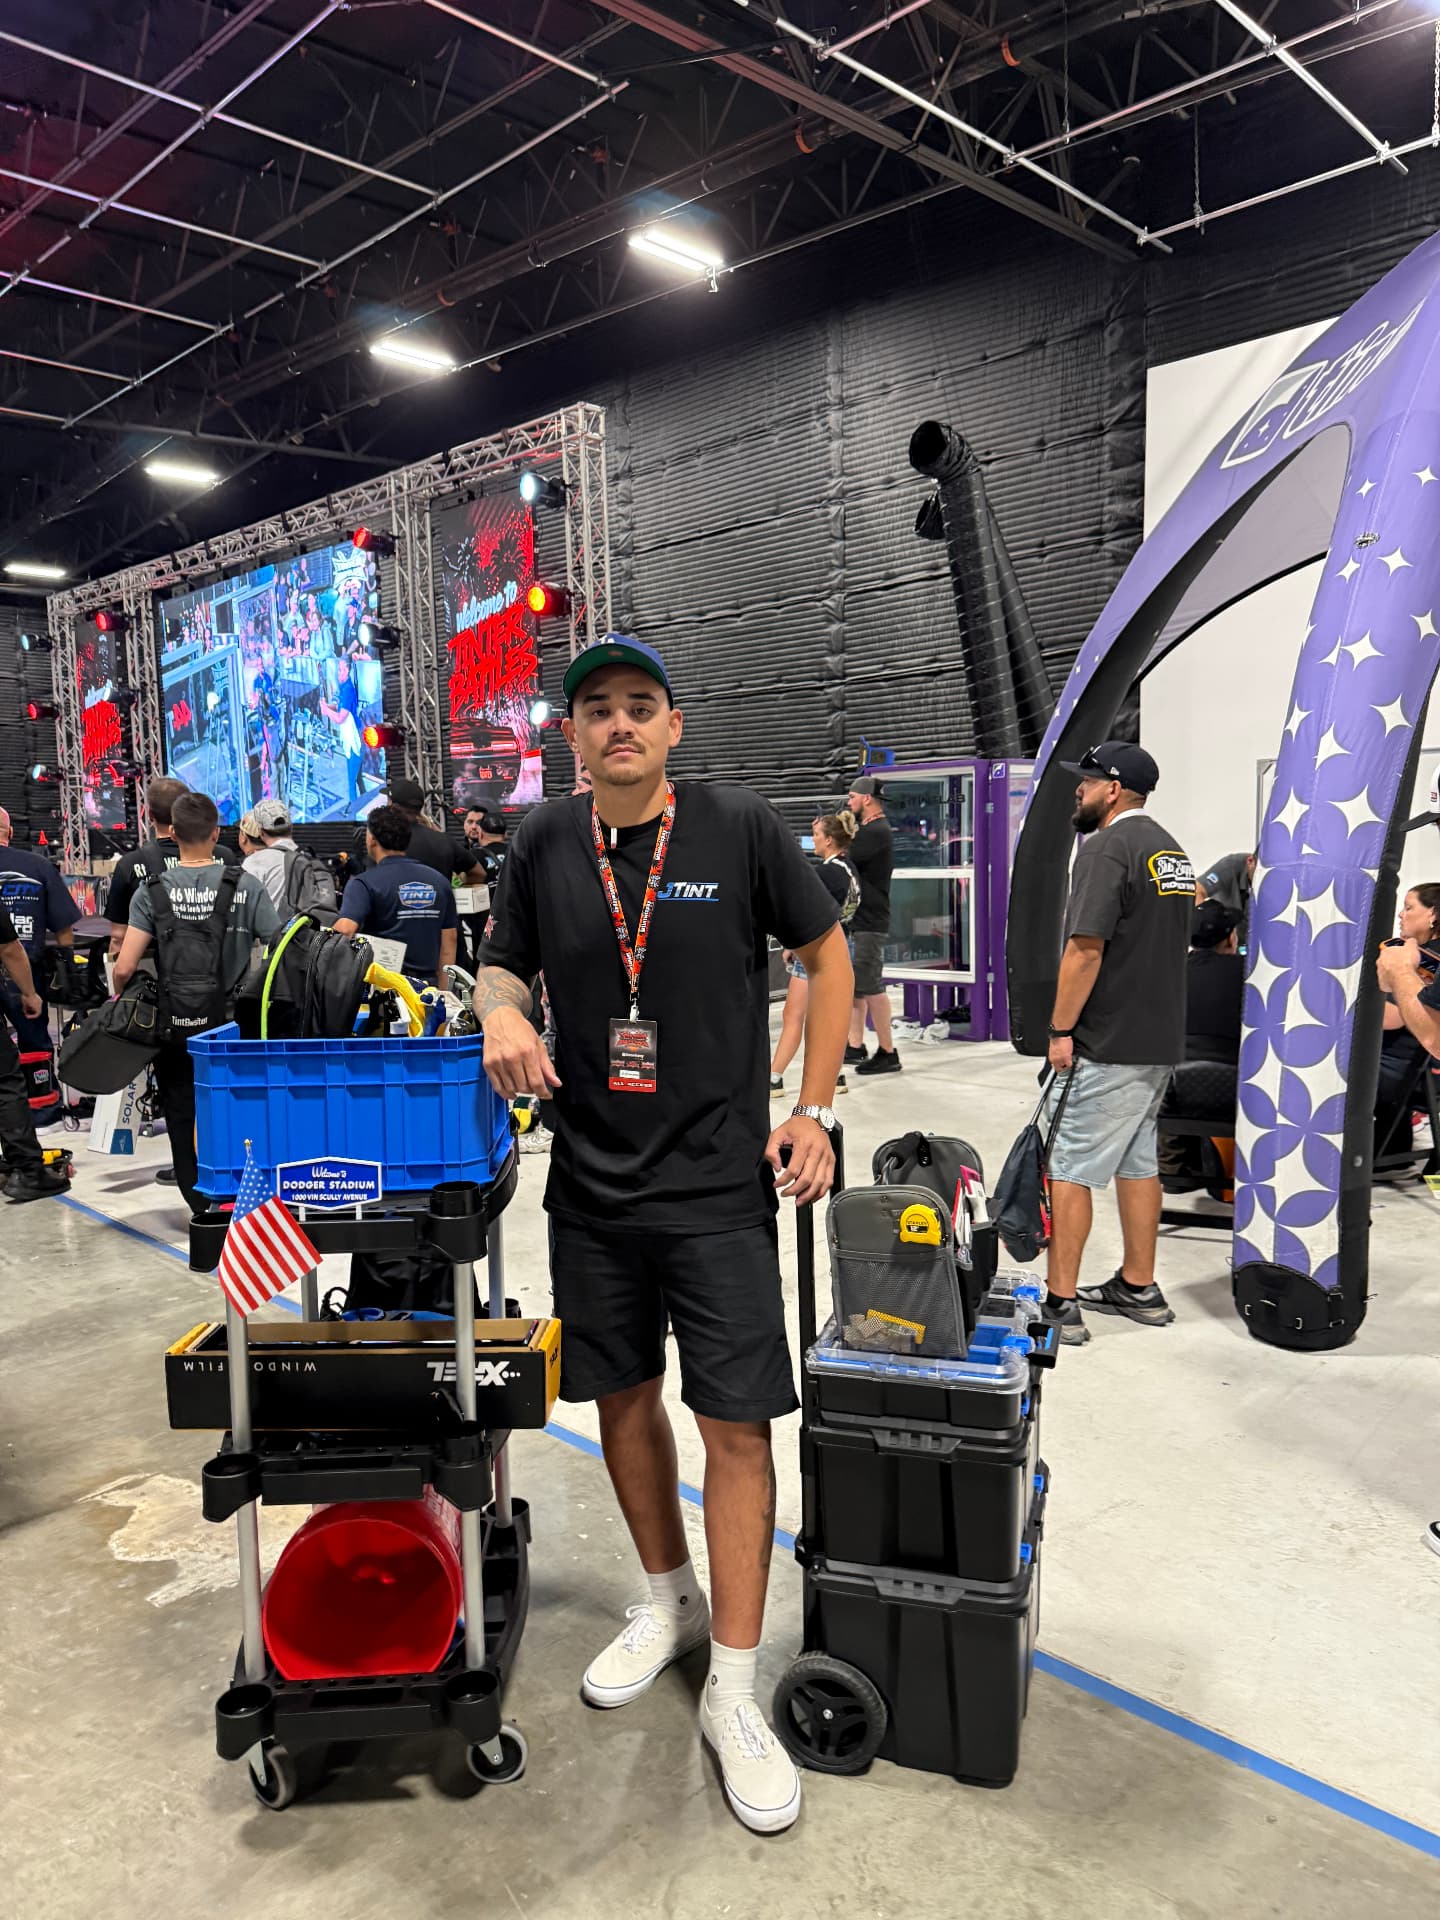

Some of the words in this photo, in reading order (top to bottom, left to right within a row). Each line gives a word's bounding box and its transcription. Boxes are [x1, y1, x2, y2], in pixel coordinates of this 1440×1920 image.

[447, 602, 527, 672] TINTER
[447, 637, 538, 720] BATTLES
[169, 888, 183, 902] 46
[233, 890, 247, 904] int
[312, 1166, 339, 1178] Welcome
[283, 1180, 325, 1189] DODGER
[329, 1180, 375, 1189] STADIUM
[184, 1361, 224, 1372] FILM
[254, 1361, 317, 1372] WINDO
